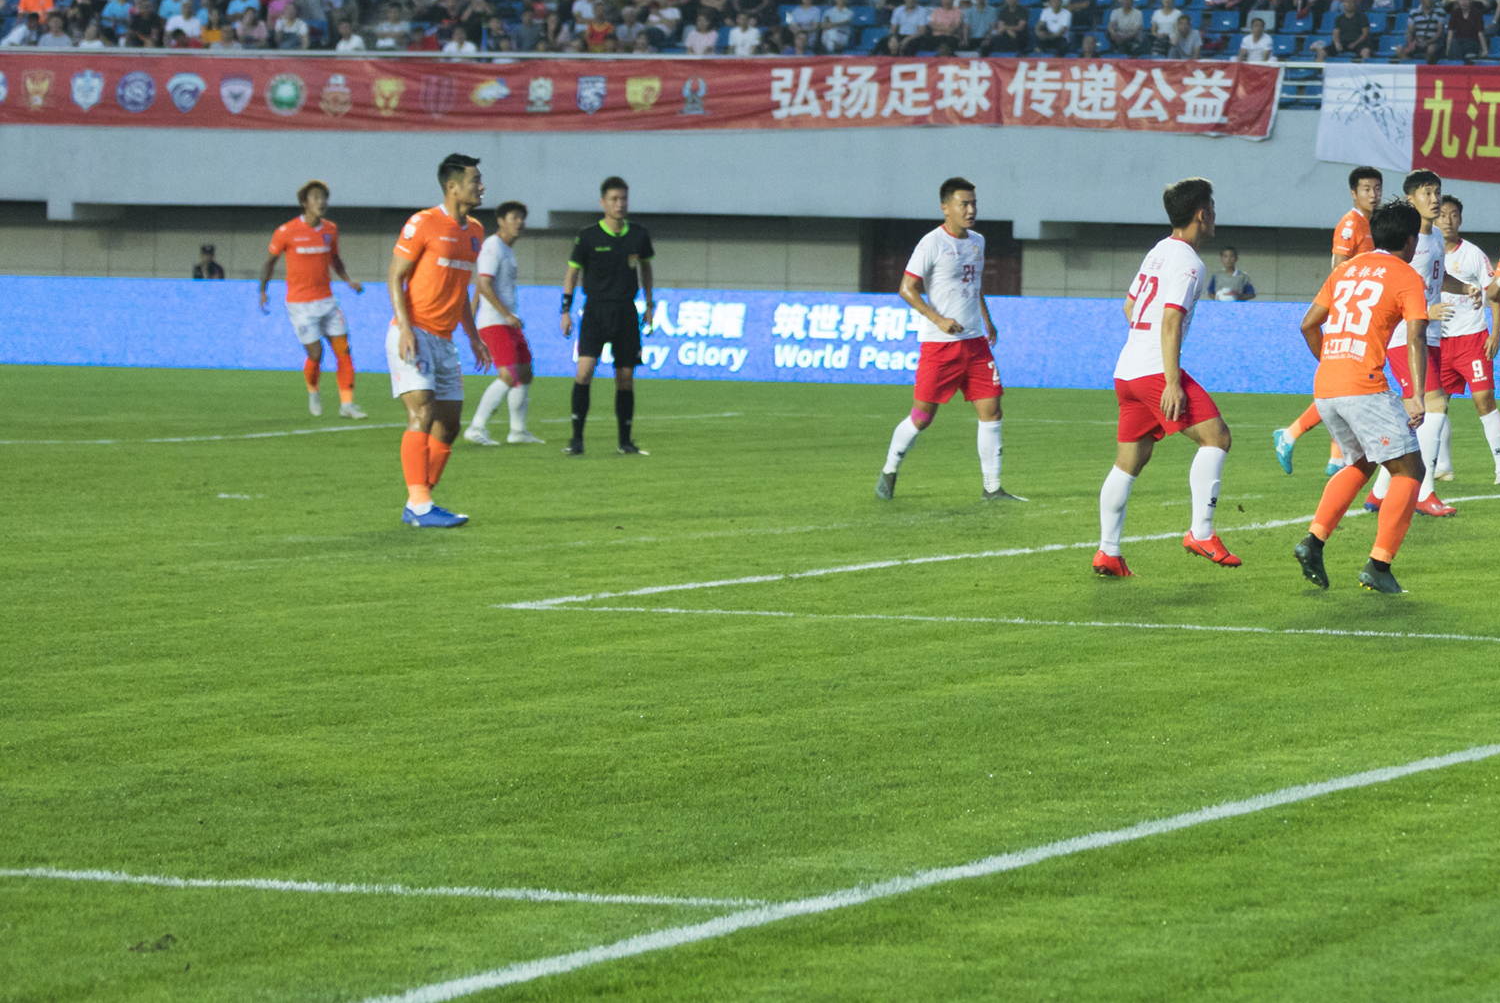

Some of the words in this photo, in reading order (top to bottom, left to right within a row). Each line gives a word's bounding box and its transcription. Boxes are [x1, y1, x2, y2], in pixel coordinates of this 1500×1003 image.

[770, 60, 993, 119] 弘扬足球
[1005, 61, 1233, 125] 传递公益
[1432, 260, 1440, 280] 6
[1324, 279, 1384, 336] 33
[678, 341, 748, 373] Glory
[774, 344, 849, 369] World
[859, 347, 918, 371] Peac
[1472, 359, 1484, 378] 9
[987, 360, 1001, 382] 2
